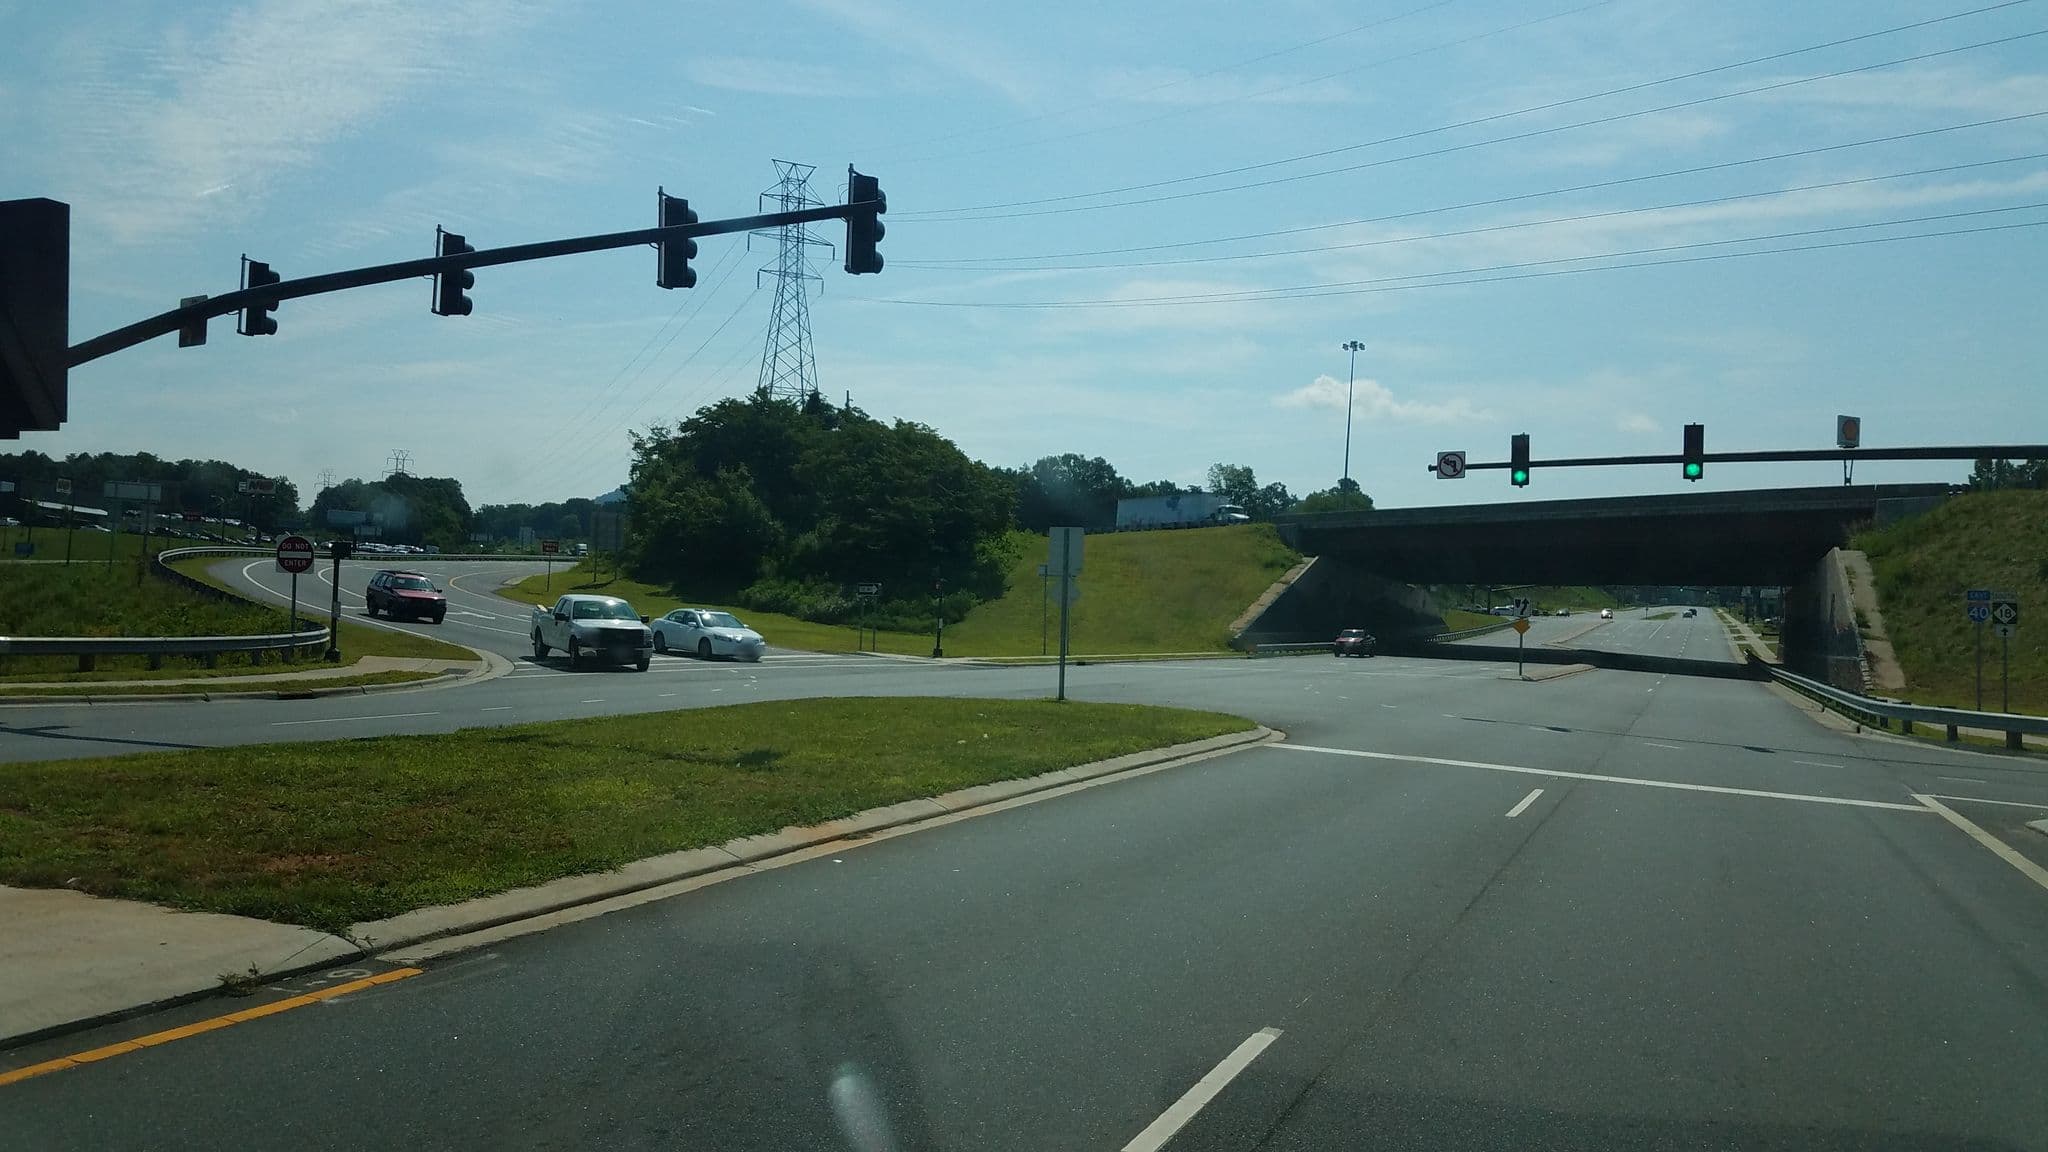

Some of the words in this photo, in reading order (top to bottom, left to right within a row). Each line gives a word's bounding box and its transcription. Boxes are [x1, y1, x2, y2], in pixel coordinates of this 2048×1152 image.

[282, 542, 291, 550] DO
[295, 542, 309, 550] NOT
[1969, 607, 1989, 619] 40
[2000, 608, 2011, 618] 18
